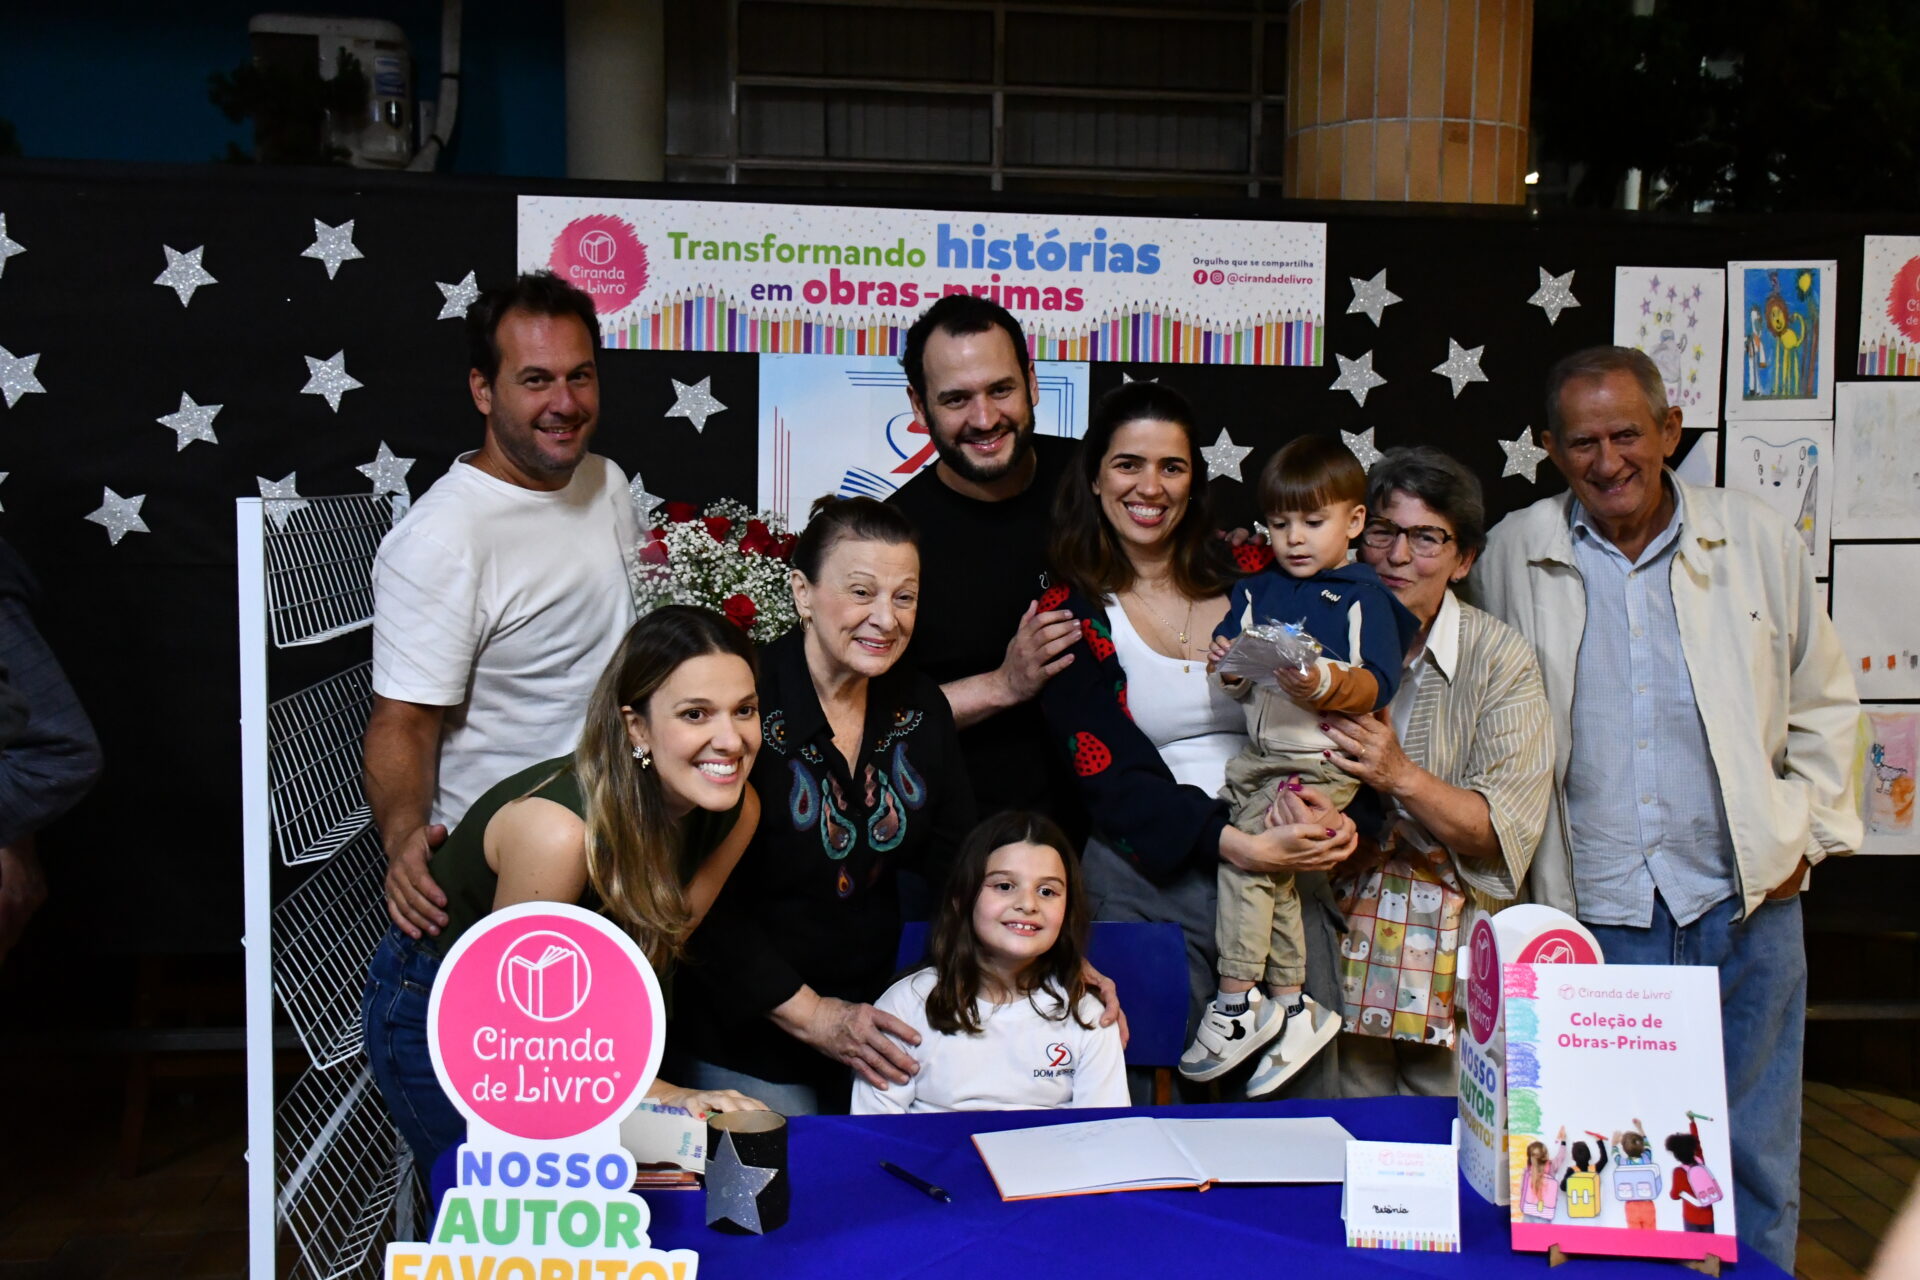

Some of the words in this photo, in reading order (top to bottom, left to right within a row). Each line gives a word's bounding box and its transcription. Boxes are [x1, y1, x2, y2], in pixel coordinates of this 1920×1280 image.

[667, 231, 926, 267] Transformando
[936, 222, 1161, 275] histórias
[1193, 256, 1230, 267] Orgulho
[1232, 260, 1248, 268] que
[1261, 259, 1314, 269] compartilha
[569, 264, 625, 280] Ciranda
[1227, 272, 1313, 285] @cirandadelivro
[750, 283, 793, 301] em
[1578, 987, 1623, 999] Ciranda
[1625, 989, 1640, 999] de
[1570, 1012, 1637, 1030] Coleção
[1641, 1013, 1663, 1029] de
[472, 1026, 615, 1062] Ciranda
[1557, 1033, 1678, 1051] Obras-Primas
[1033, 1069, 1054, 1078] DOM
[1461, 1037, 1496, 1094] NOSSO
[472, 1074, 507, 1101] de
[1460, 1069, 1495, 1127] AUTOR
[462, 1151, 629, 1190] NOSSO
[437, 1197, 641, 1250] AUTOR
